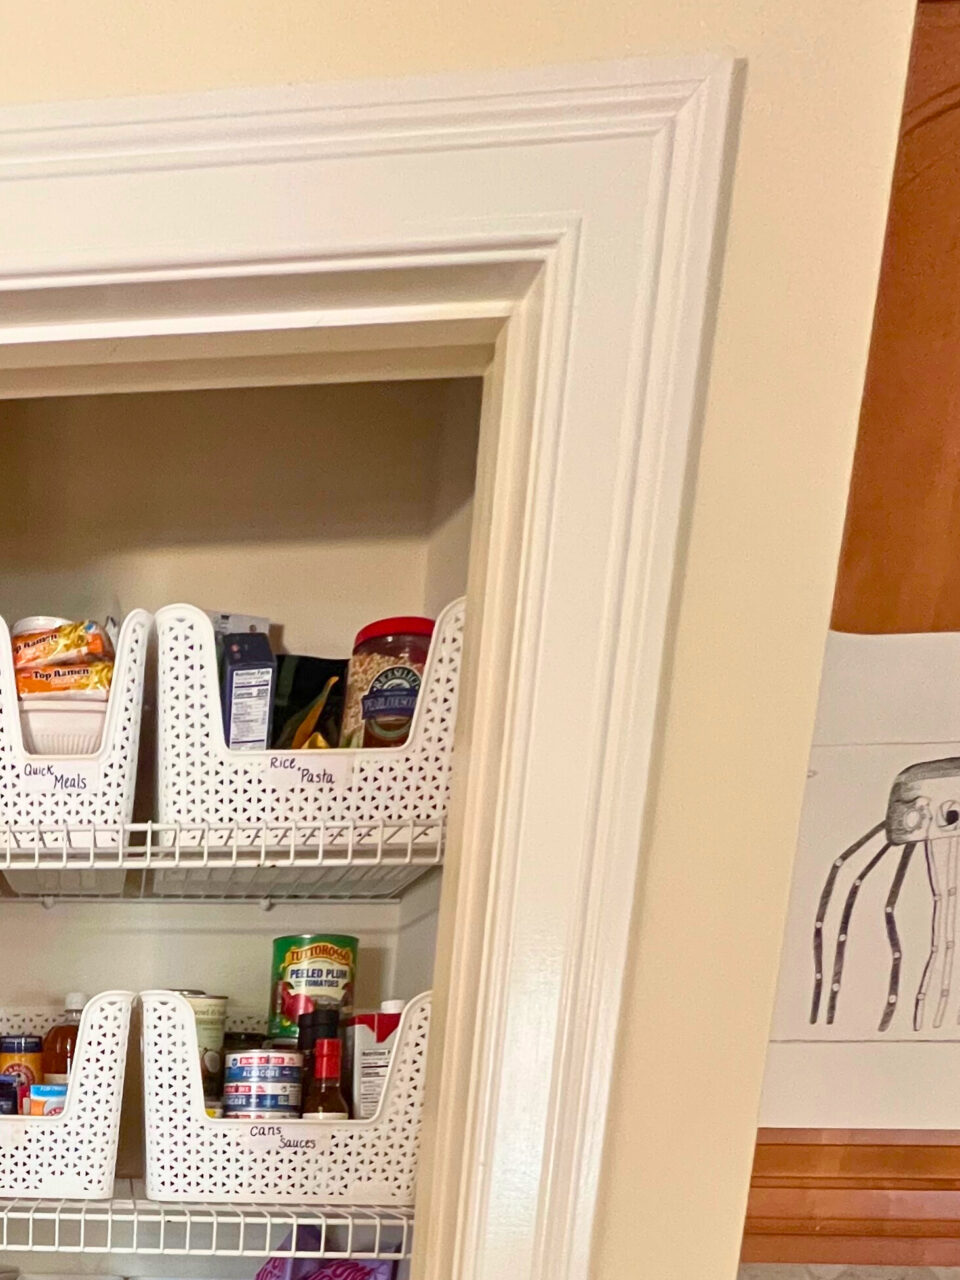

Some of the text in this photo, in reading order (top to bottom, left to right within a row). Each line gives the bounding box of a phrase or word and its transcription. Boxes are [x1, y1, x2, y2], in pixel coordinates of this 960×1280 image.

[33, 668, 89, 681] Top Ramen
[24, 763, 54, 777] Quick
[301, 768, 335, 784] Pasta
[53, 774, 87, 790] Meals
[290, 968, 348, 979] PEELED PLUM
[305, 980, 340, 988] TOMATOES
[279, 1137, 316, 1149] Sauces
